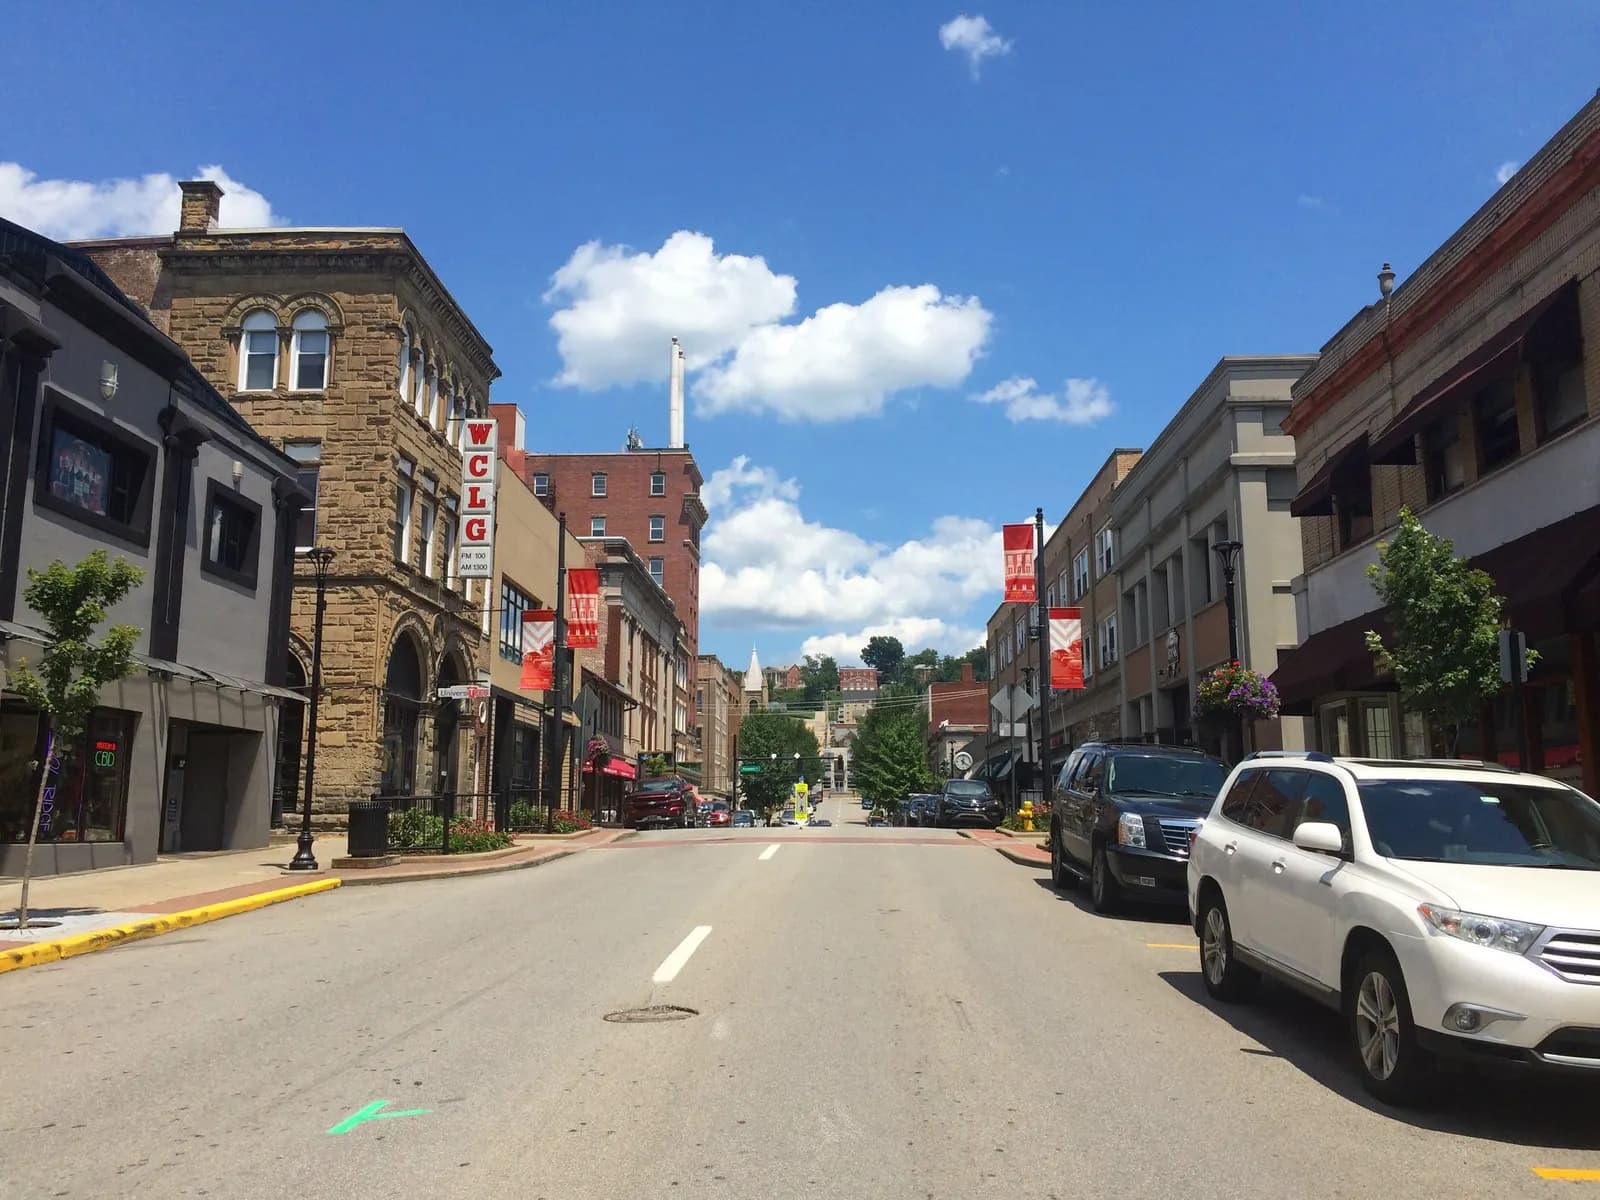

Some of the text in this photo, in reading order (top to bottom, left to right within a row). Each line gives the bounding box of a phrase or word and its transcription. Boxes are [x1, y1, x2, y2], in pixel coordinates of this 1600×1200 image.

[465, 423, 493, 541] WCLG
[461, 552, 486, 560] FM 100
[460, 563, 488, 571] AM 1300
[95, 751, 115, 767] CBD
